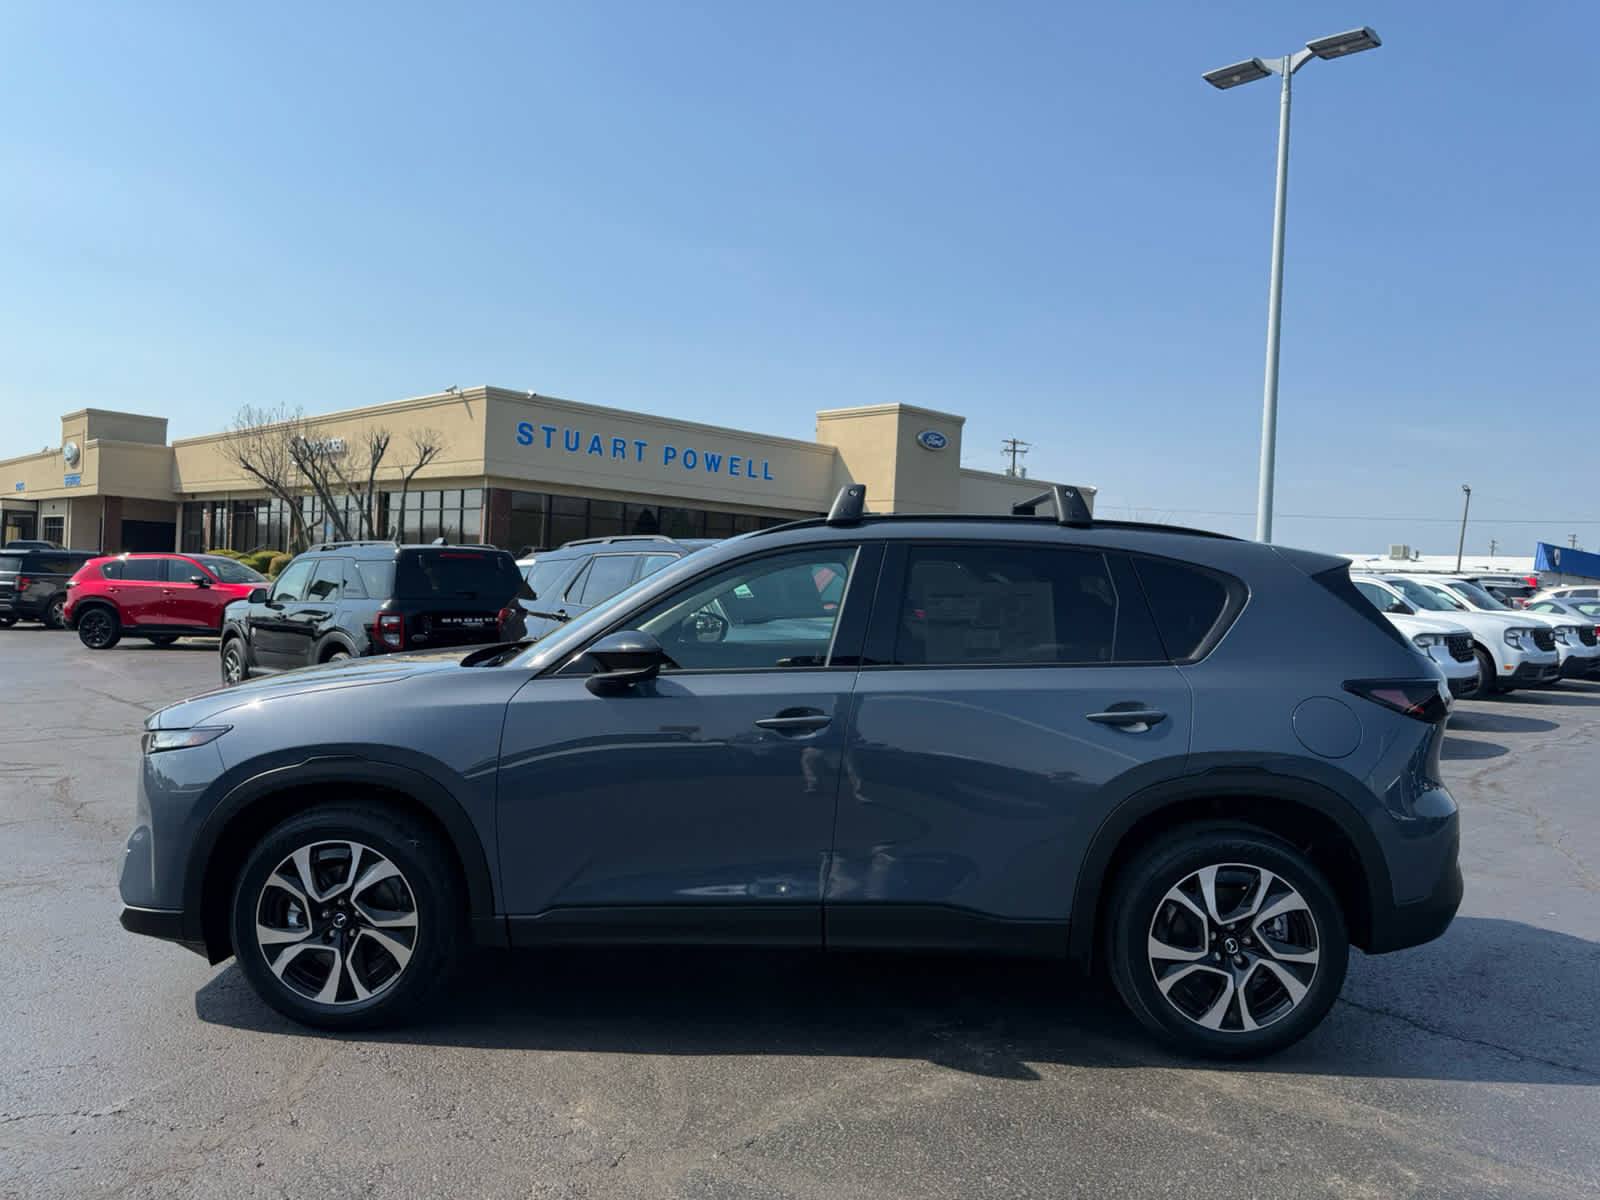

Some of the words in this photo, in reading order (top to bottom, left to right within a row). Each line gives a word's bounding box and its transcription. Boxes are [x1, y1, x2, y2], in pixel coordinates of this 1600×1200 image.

[516, 421, 648, 462] STUART
[663, 445, 775, 481] POWELL
[926, 433, 945, 447] Ford
